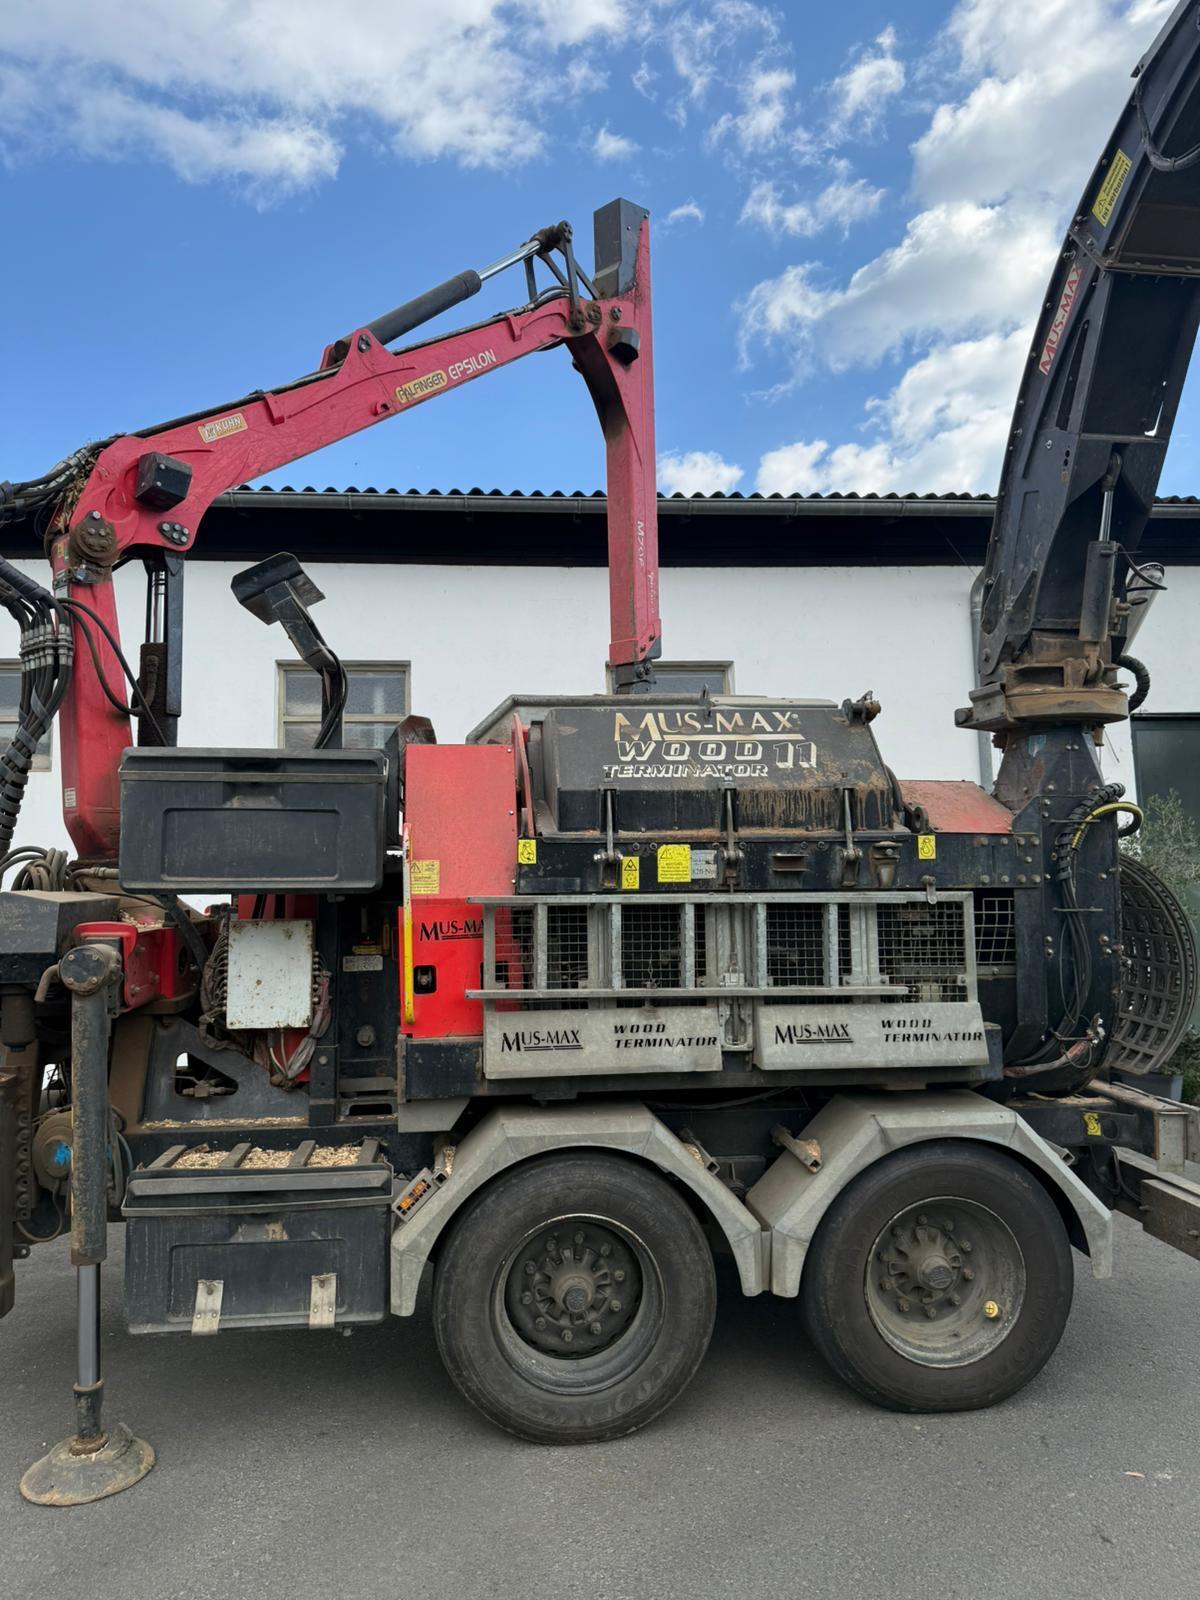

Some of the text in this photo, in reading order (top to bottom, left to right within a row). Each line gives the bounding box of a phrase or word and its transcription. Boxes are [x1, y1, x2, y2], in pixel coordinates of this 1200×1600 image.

[1040, 264, 1081, 375] MUS-MAX
[397, 348, 497, 402] PALFINGER EPSILON
[215, 415, 242, 432] KUHN
[614, 711, 794, 741] MUS-MAX
[617, 740, 817, 769] WOOD 11
[602, 763, 769, 778] TERMINATOR
[419, 919, 485, 942] MUS-MA
[613, 1023, 667, 1034] WOOD
[775, 1023, 851, 1045] MUS-MAX
[881, 1019, 932, 1029] WOOD
[501, 1029, 581, 1052] MUS-MAX
[614, 1036, 718, 1048] TERMINATOR
[884, 1031, 983, 1043] TERMINATOR
